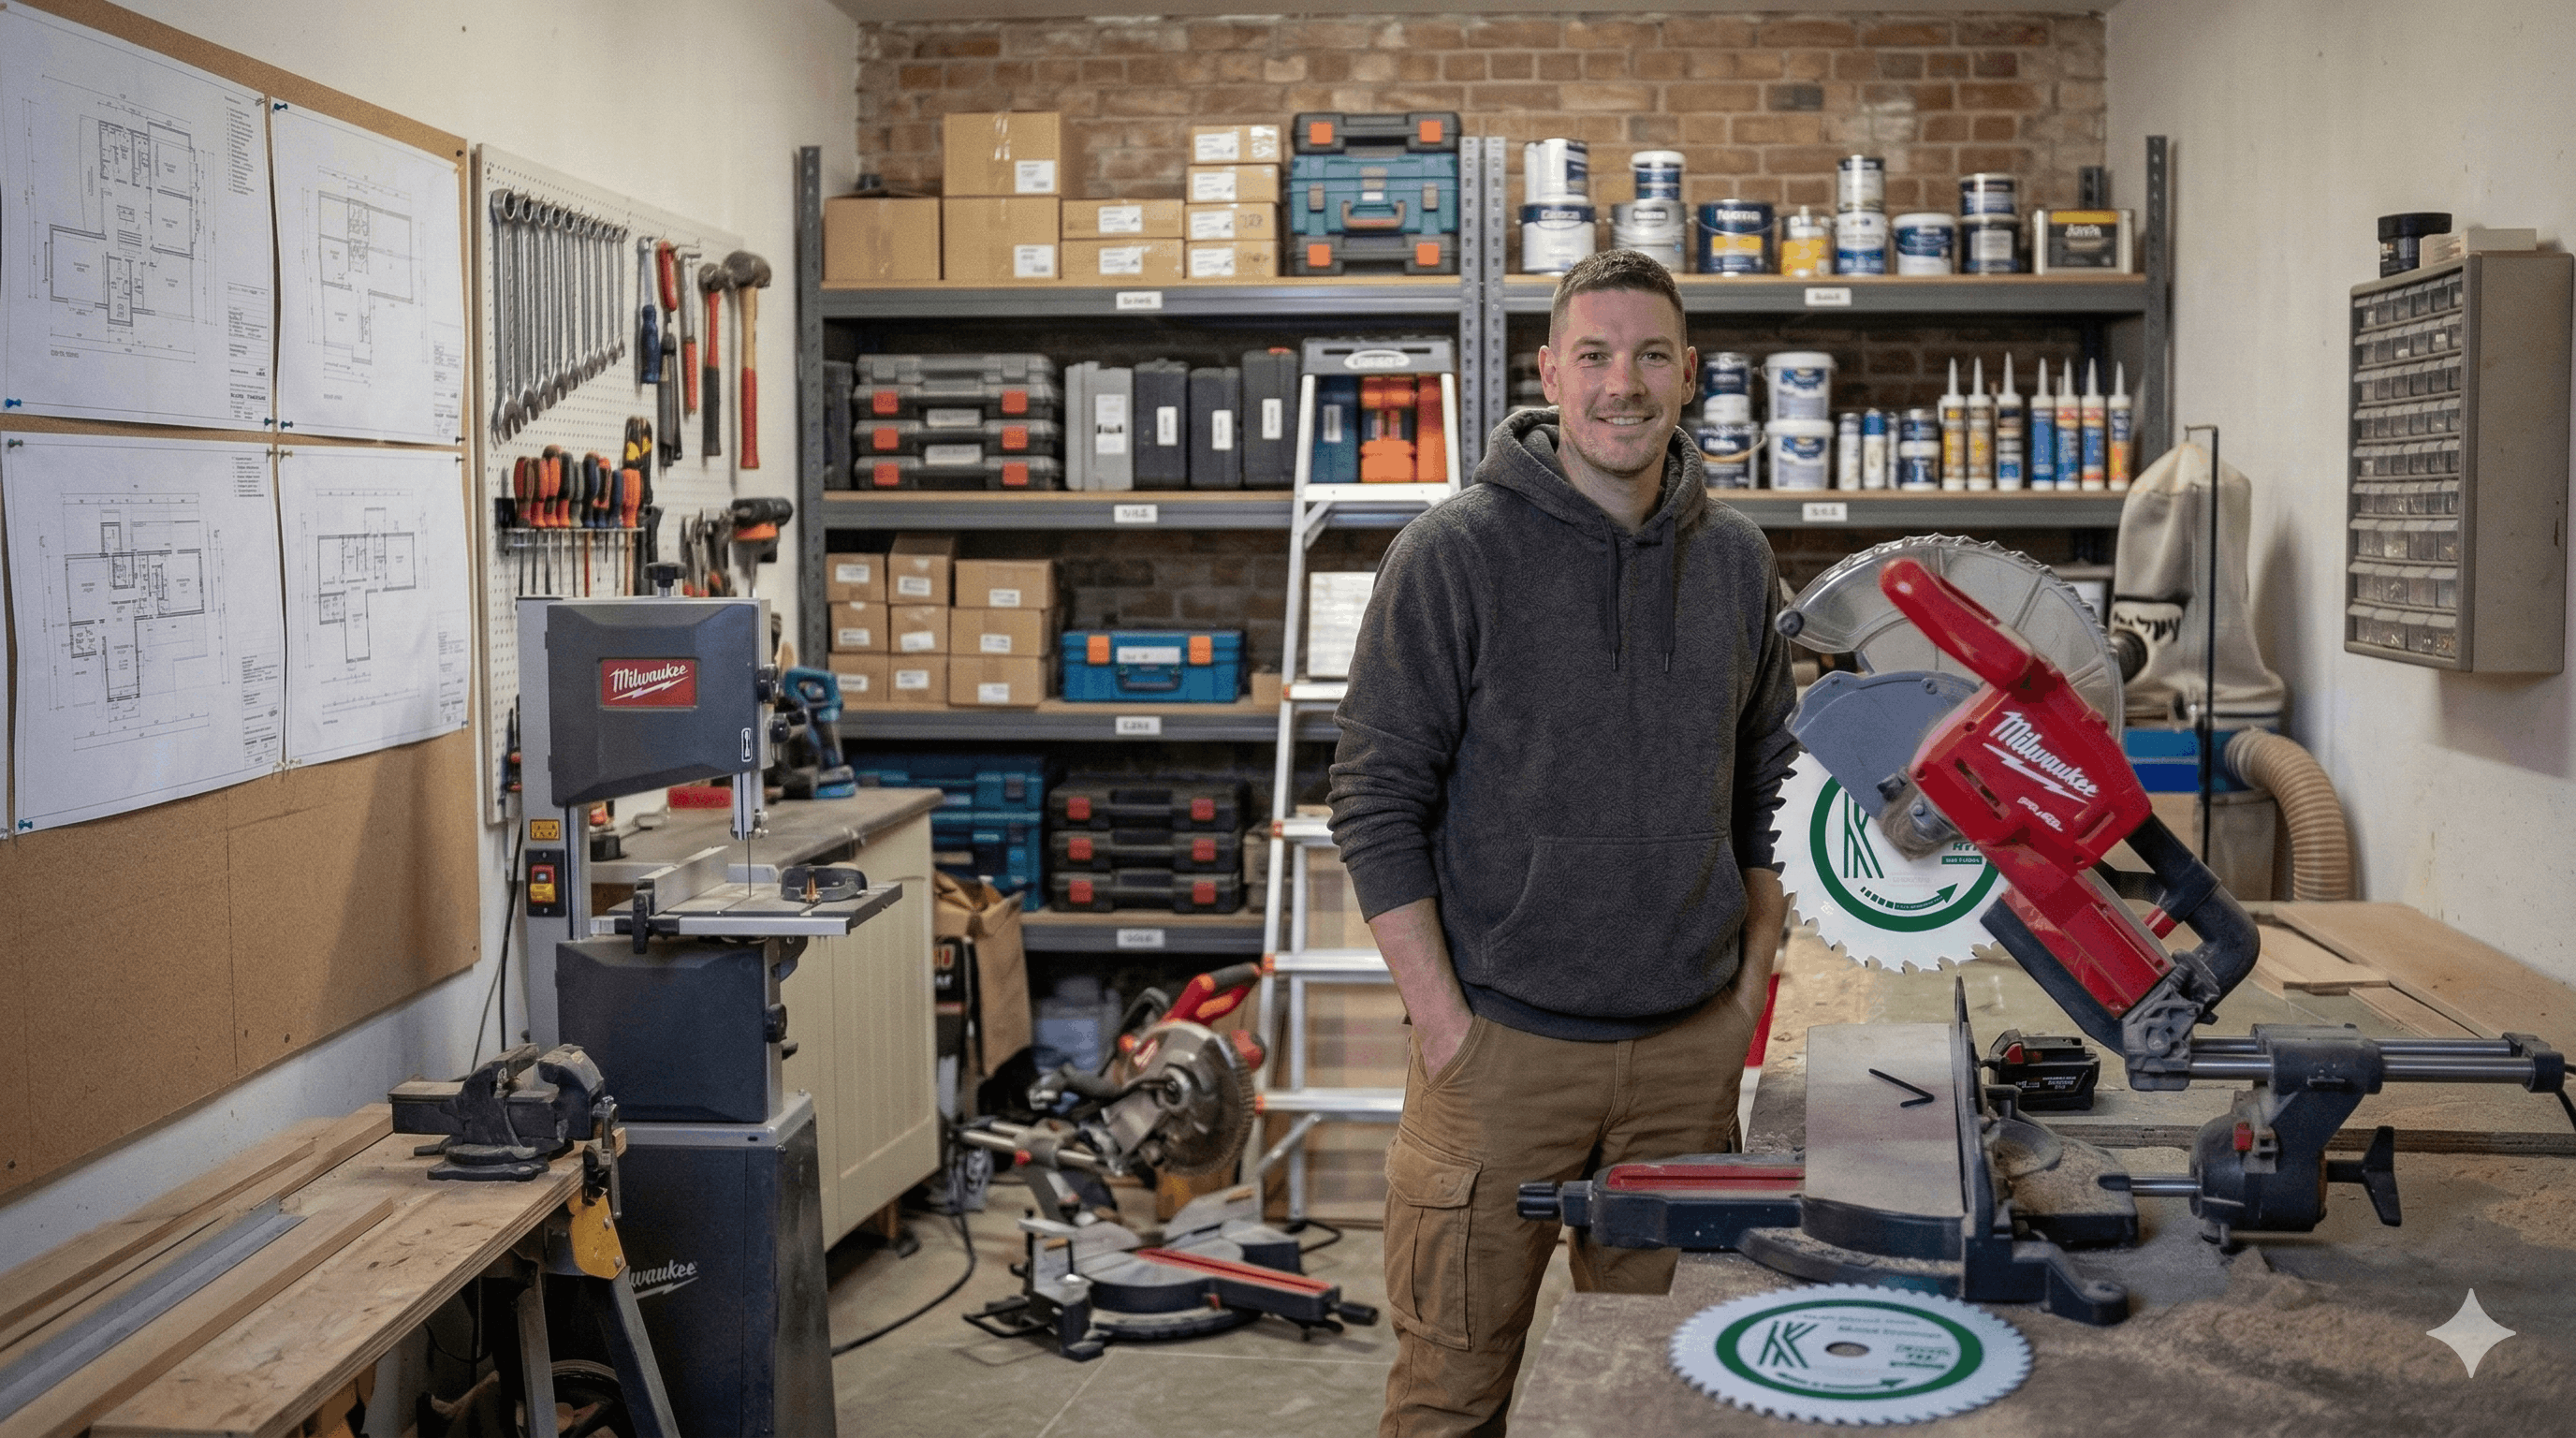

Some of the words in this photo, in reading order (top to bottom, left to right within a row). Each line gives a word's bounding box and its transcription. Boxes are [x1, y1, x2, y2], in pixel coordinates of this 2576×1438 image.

[608, 663, 689, 693] Milwaukee
[1988, 711, 2098, 798] Milwaukee
[630, 1259, 697, 1288] waukee
